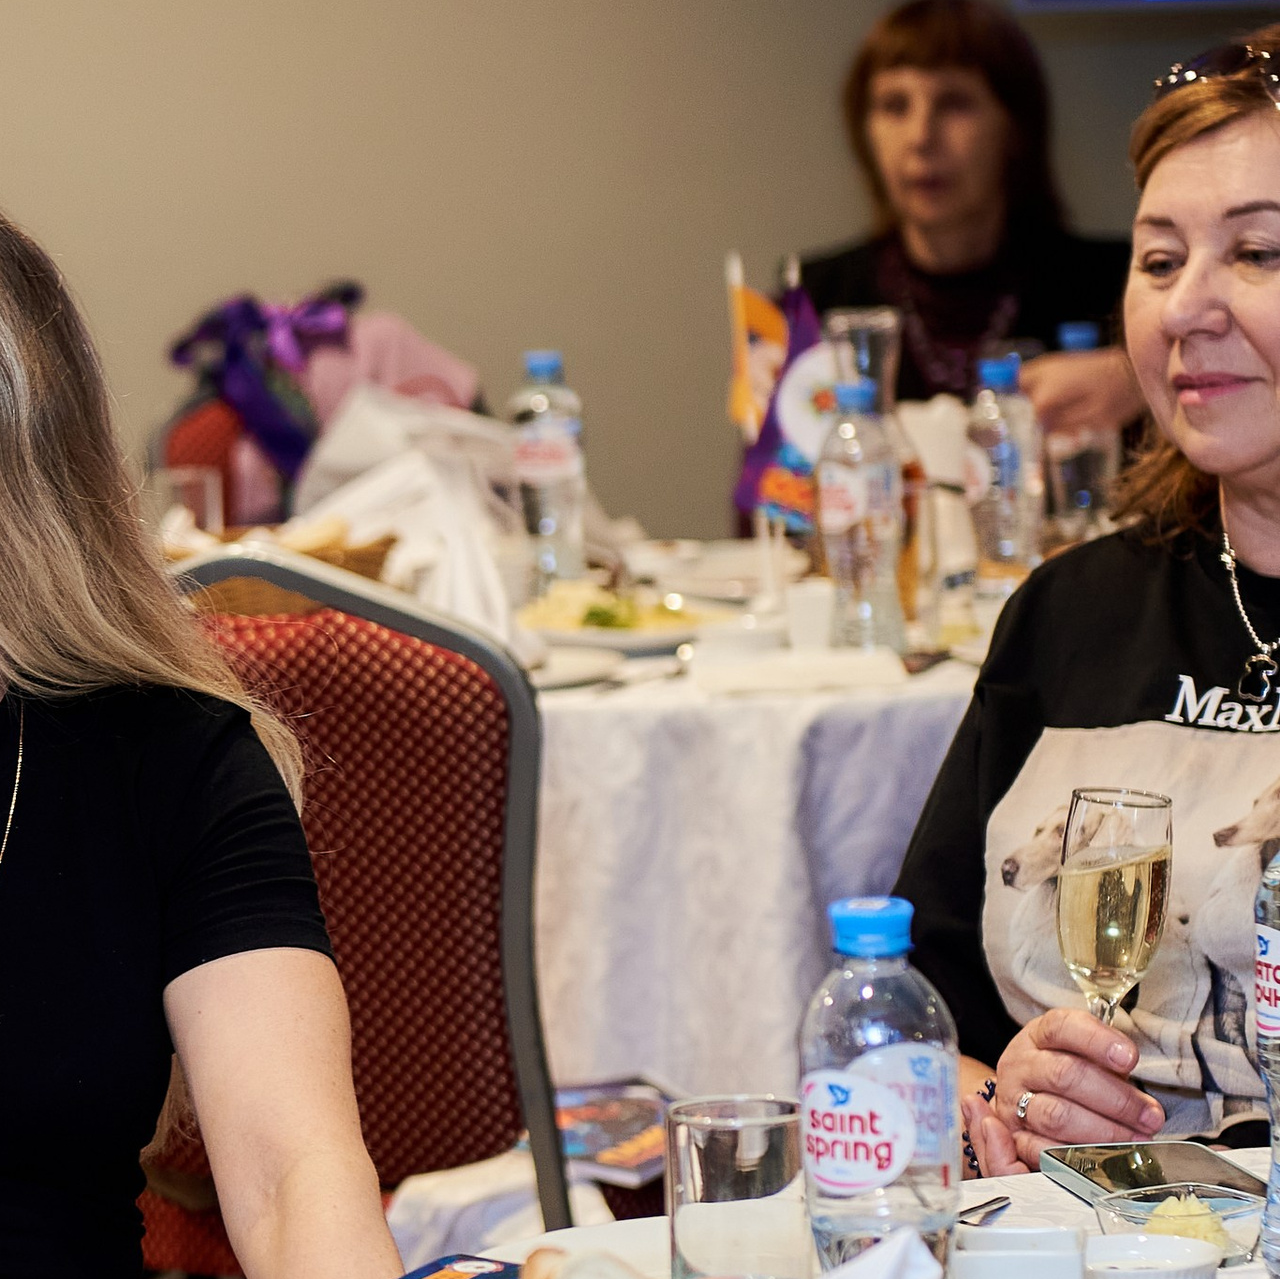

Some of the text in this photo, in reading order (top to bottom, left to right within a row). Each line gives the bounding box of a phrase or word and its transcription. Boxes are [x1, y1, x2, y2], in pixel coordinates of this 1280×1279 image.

[1164, 673, 1280, 732] Max
[810, 1109, 882, 1135] saint
[806, 1133, 893, 1171] spring
